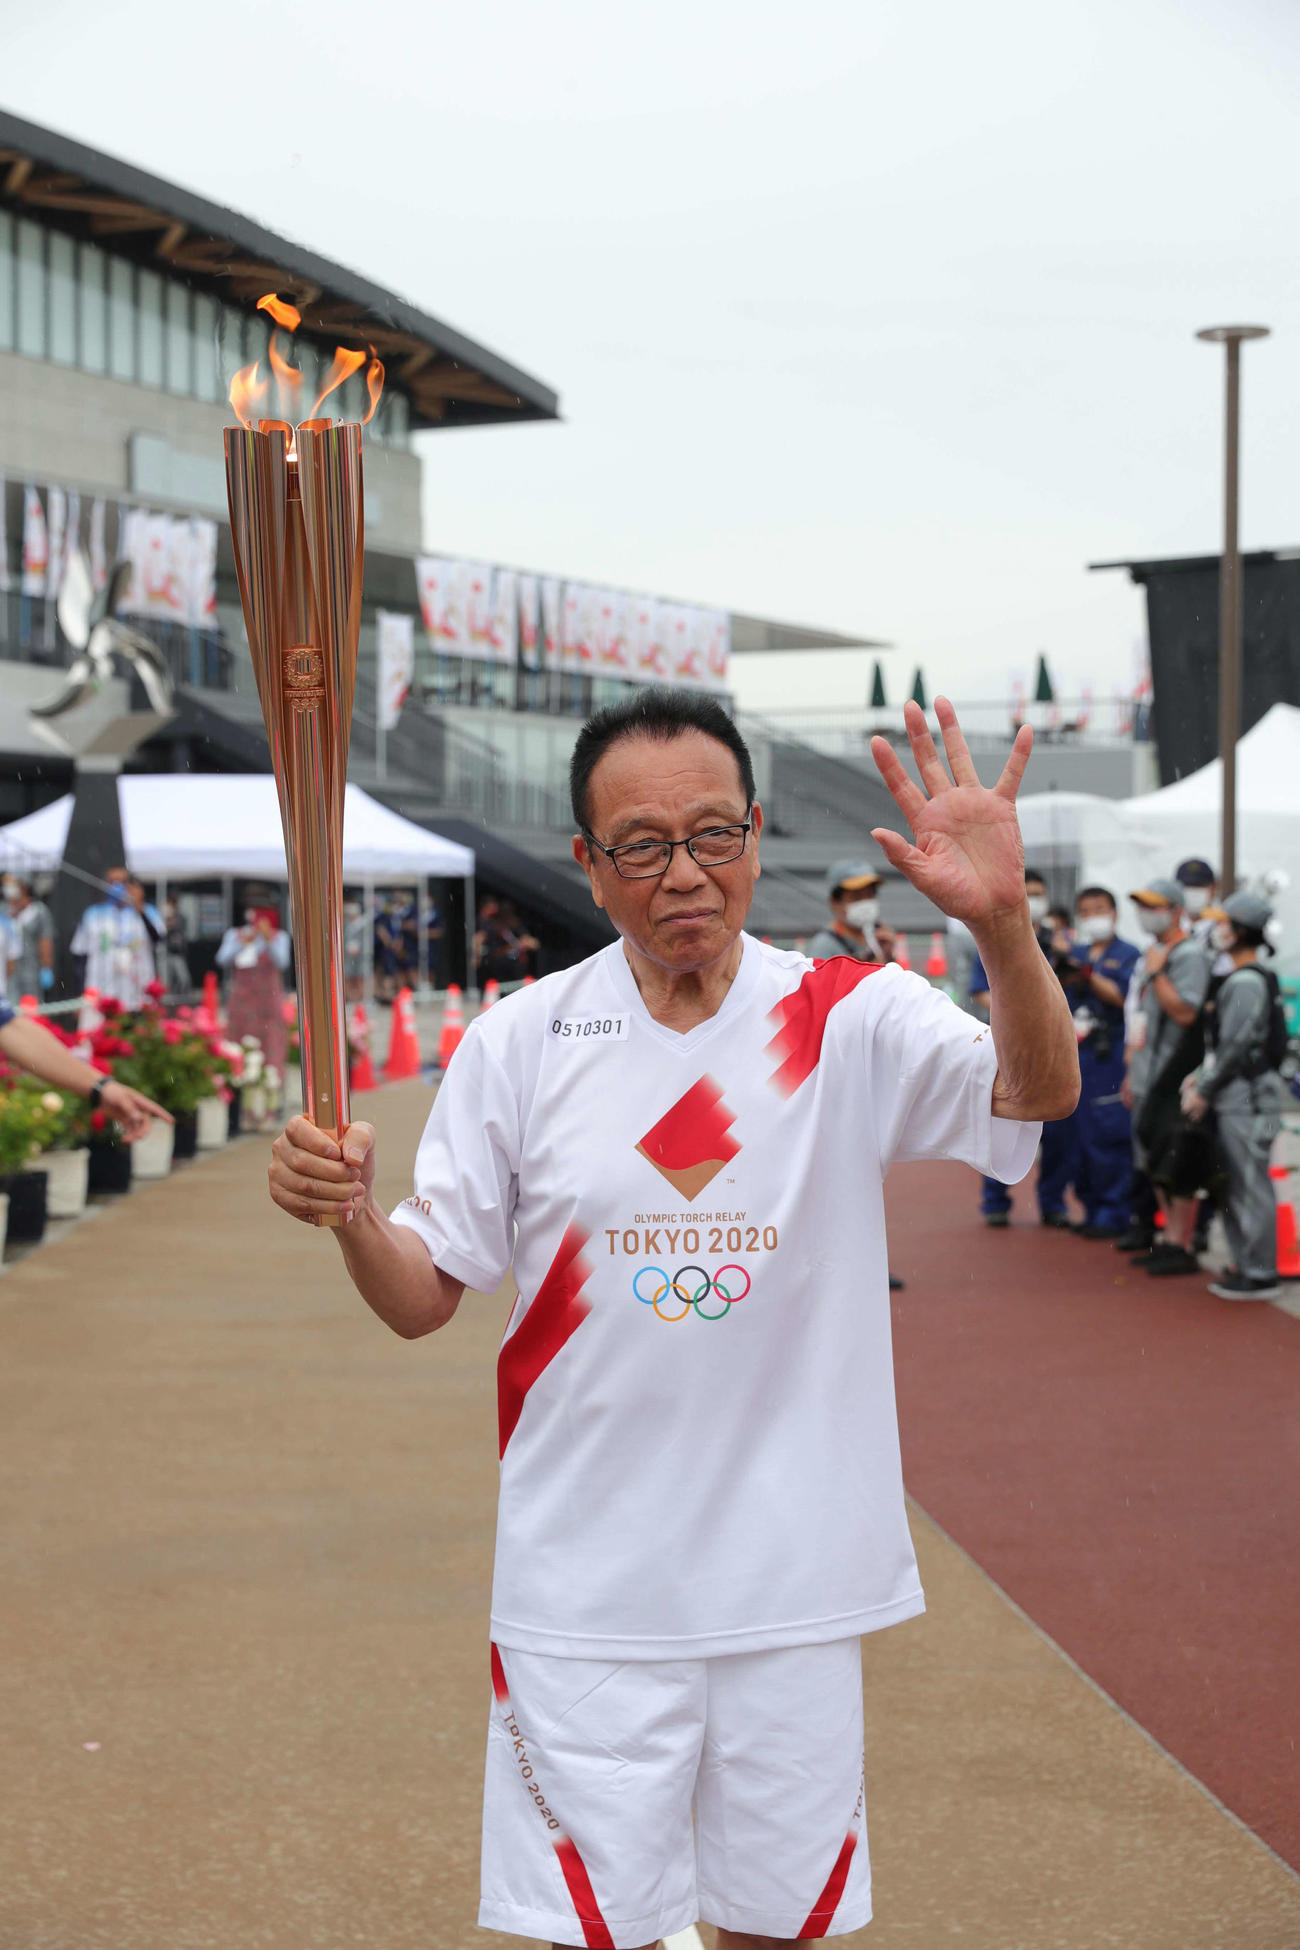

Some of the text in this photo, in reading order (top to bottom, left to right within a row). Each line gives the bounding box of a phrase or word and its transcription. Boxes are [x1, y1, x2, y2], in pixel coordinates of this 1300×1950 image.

[552, 1019, 622, 1037] 0510301
[634, 1211, 747, 1224] OLYMPIC TORCH RELAY
[604, 1225, 778, 1256] TOKYO 2020
[503, 1710, 560, 1831] TOKYO 2020
